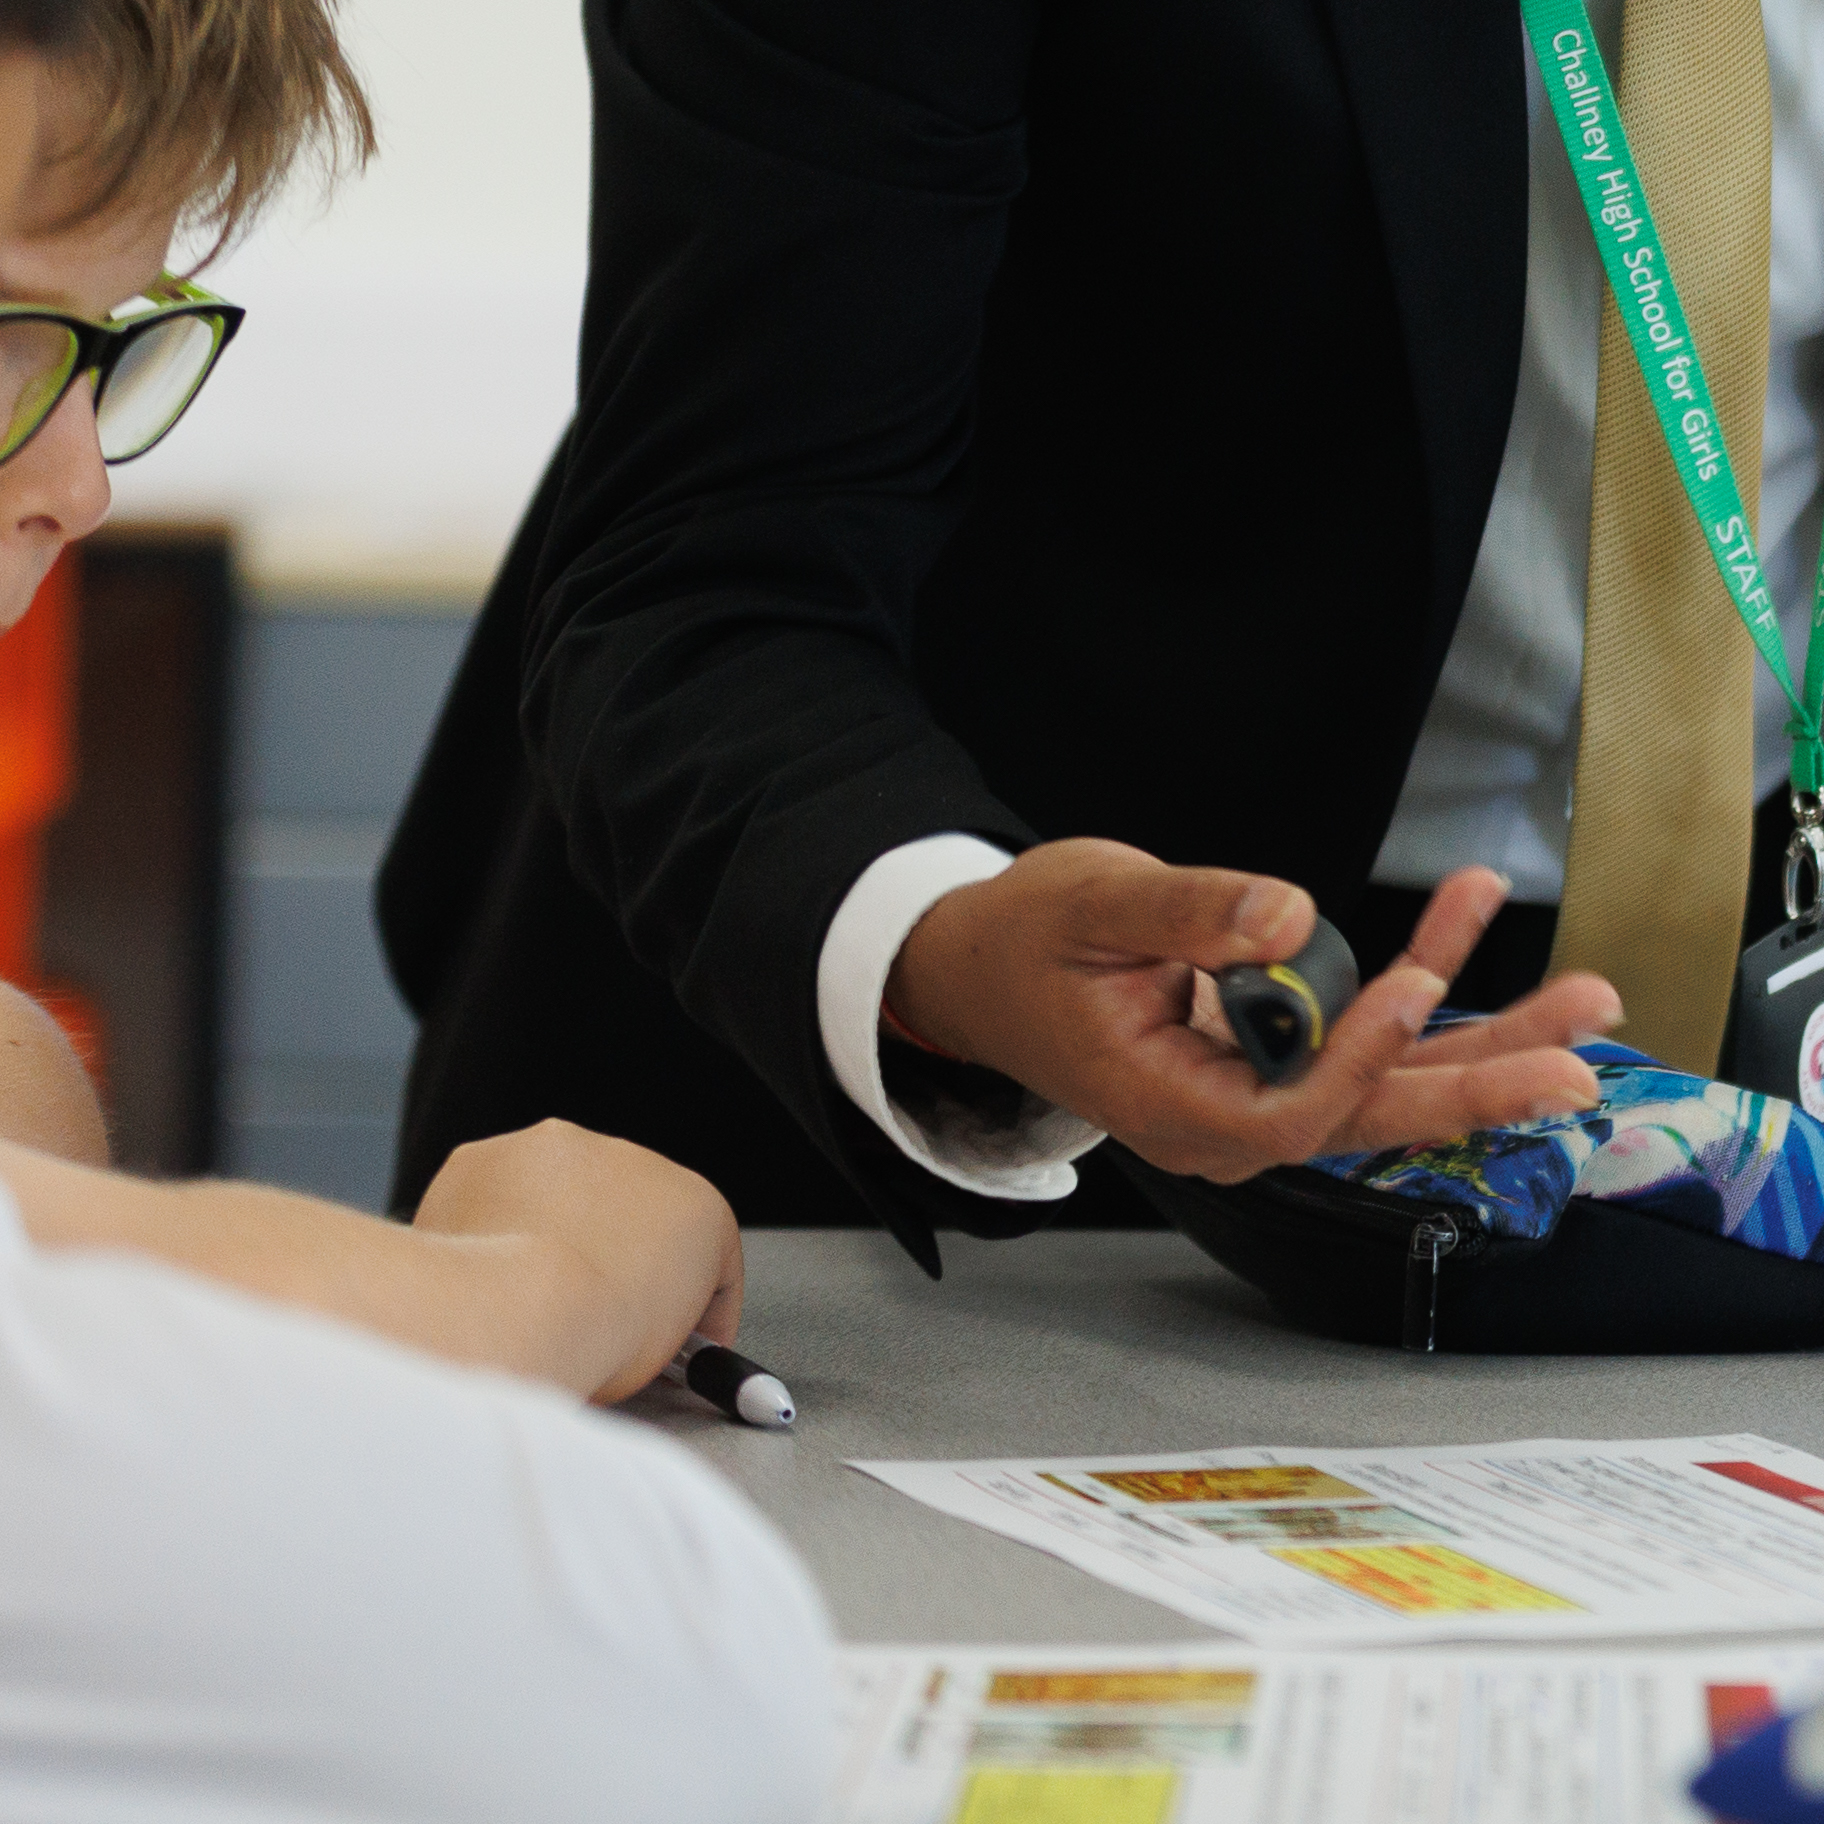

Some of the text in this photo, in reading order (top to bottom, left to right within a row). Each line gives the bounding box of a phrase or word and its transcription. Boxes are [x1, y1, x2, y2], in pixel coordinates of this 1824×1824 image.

[1552, 29, 1613, 161] Challney
[1596, 168, 1643, 243] High
[1623, 247, 1683, 353] School
[1662, 355, 1694, 402] for
[1681, 408, 1720, 482] Girls
[1716, 515, 1776, 632] STAFF
